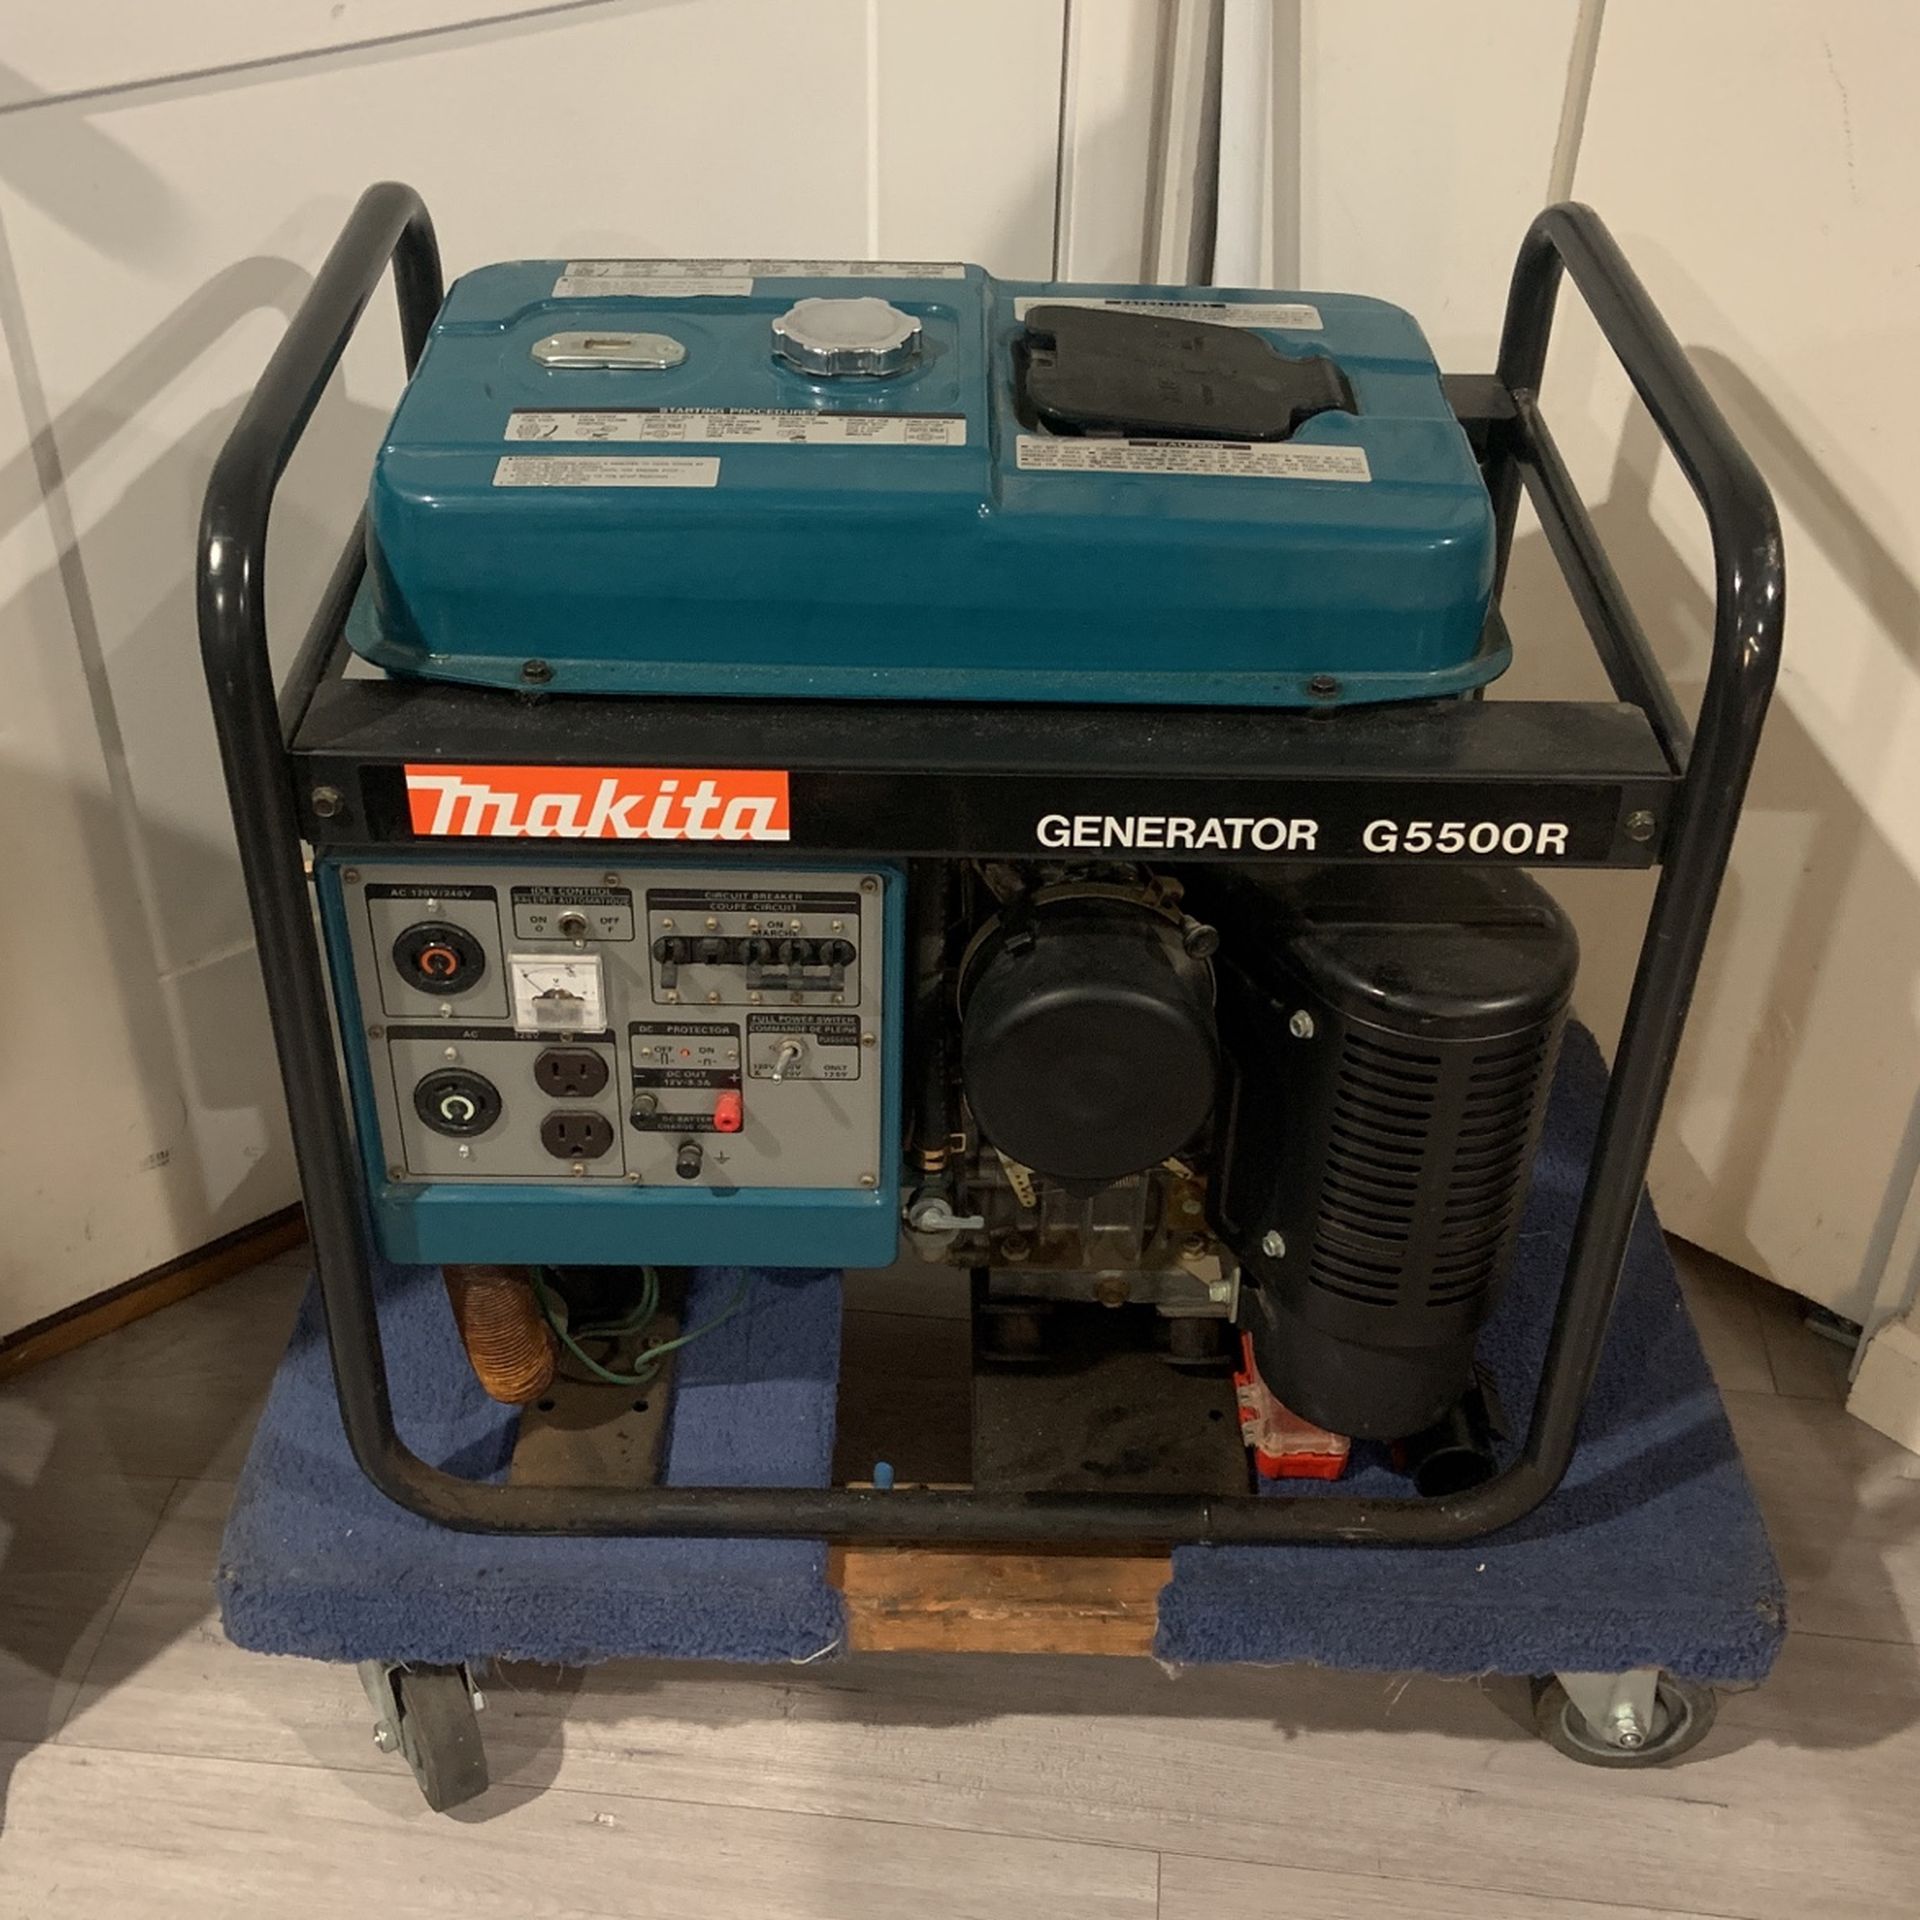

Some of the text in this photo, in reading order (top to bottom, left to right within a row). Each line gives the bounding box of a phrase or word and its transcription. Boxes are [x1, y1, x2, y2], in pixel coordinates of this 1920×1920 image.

[408, 775, 788, 839] makita
[1036, 814, 1569, 856] GENERATOR G5500R
[391, 889, 406, 897] AC
[531, 887, 610, 897] IDLE CONTROL
[704, 891, 803, 901] CIRCUIT BREAKER
[529, 915, 547, 924] ON
[599, 917, 619, 926] OFF
[767, 920, 784, 929] ON
[752, 1015, 857, 1025] FULL POWER SWITCH
[463, 1030, 478, 1039] AC
[639, 1025, 730, 1035] DC PROTECTOR
[654, 1045, 673, 1054] OFF
[699, 1046, 716, 1055] ON
